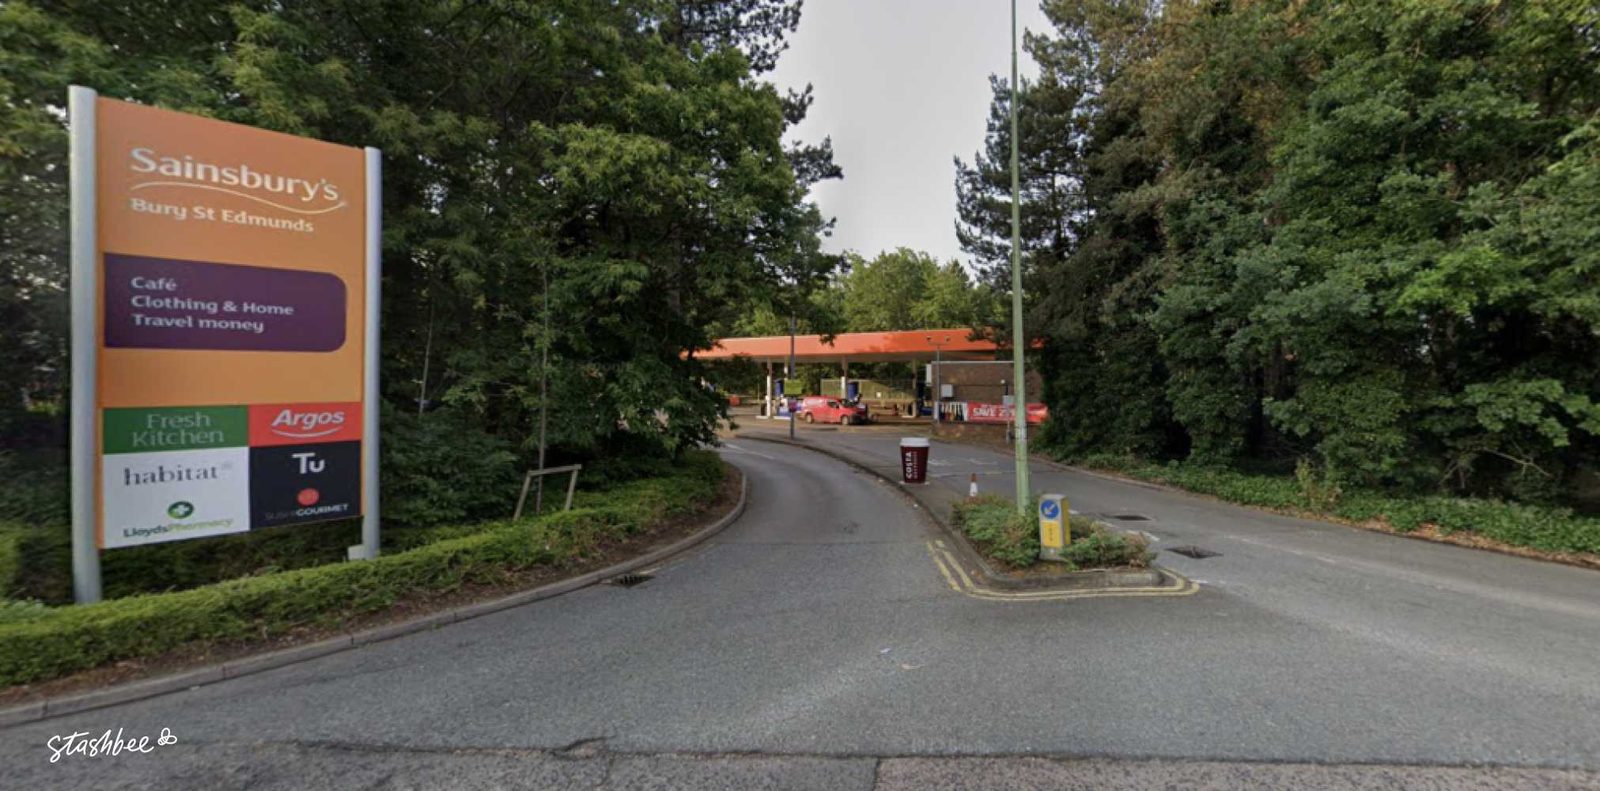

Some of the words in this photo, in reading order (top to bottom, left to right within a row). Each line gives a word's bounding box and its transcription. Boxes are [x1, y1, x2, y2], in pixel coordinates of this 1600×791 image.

[130, 147, 339, 202] Sainsbury's
[130, 198, 187, 221] Bury
[193, 205, 216, 221] St
[222, 209, 315, 233] Edmunds
[131, 276, 177, 292] Café
[131, 295, 219, 315] Clothing
[223, 301, 238, 312] &
[243, 301, 294, 316] Home
[131, 313, 193, 329] Travel
[199, 317, 265, 333] money
[147, 411, 211, 429] Fresh
[272, 409, 345, 430] Argos
[132, 428, 225, 447] Kitchen
[292, 452, 326, 474] Tu
[124, 464, 219, 486] habitat
